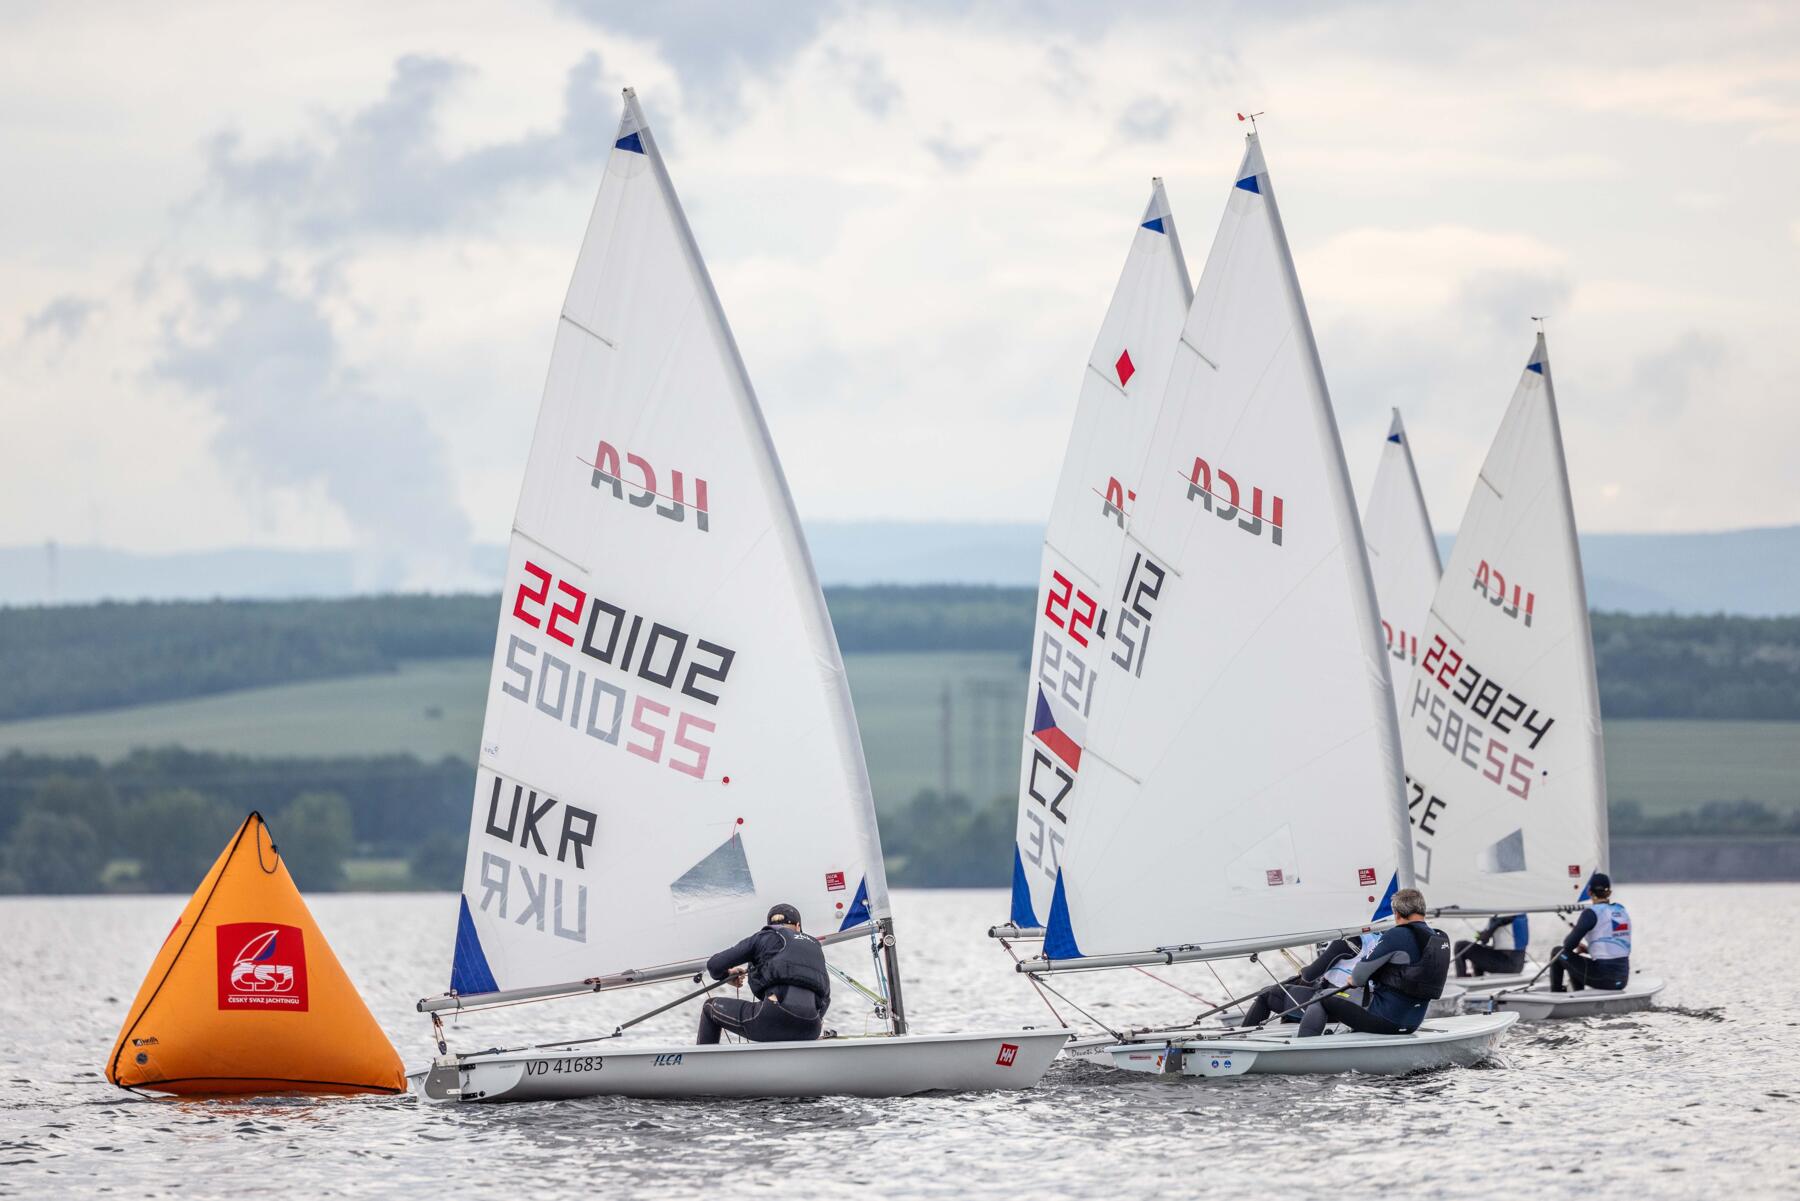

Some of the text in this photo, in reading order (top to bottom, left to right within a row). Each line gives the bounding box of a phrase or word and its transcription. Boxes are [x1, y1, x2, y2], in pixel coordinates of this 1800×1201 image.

[1122, 552, 1166, 622] 12
[513, 560, 736, 706] 220102
[1422, 634, 1555, 751] 223824
[485, 776, 598, 870] UKR
[265, 997, 300, 1005] JACHTINGU
[526, 1056, 604, 1076] VD 41683
[653, 1054, 684, 1067] ILCA
